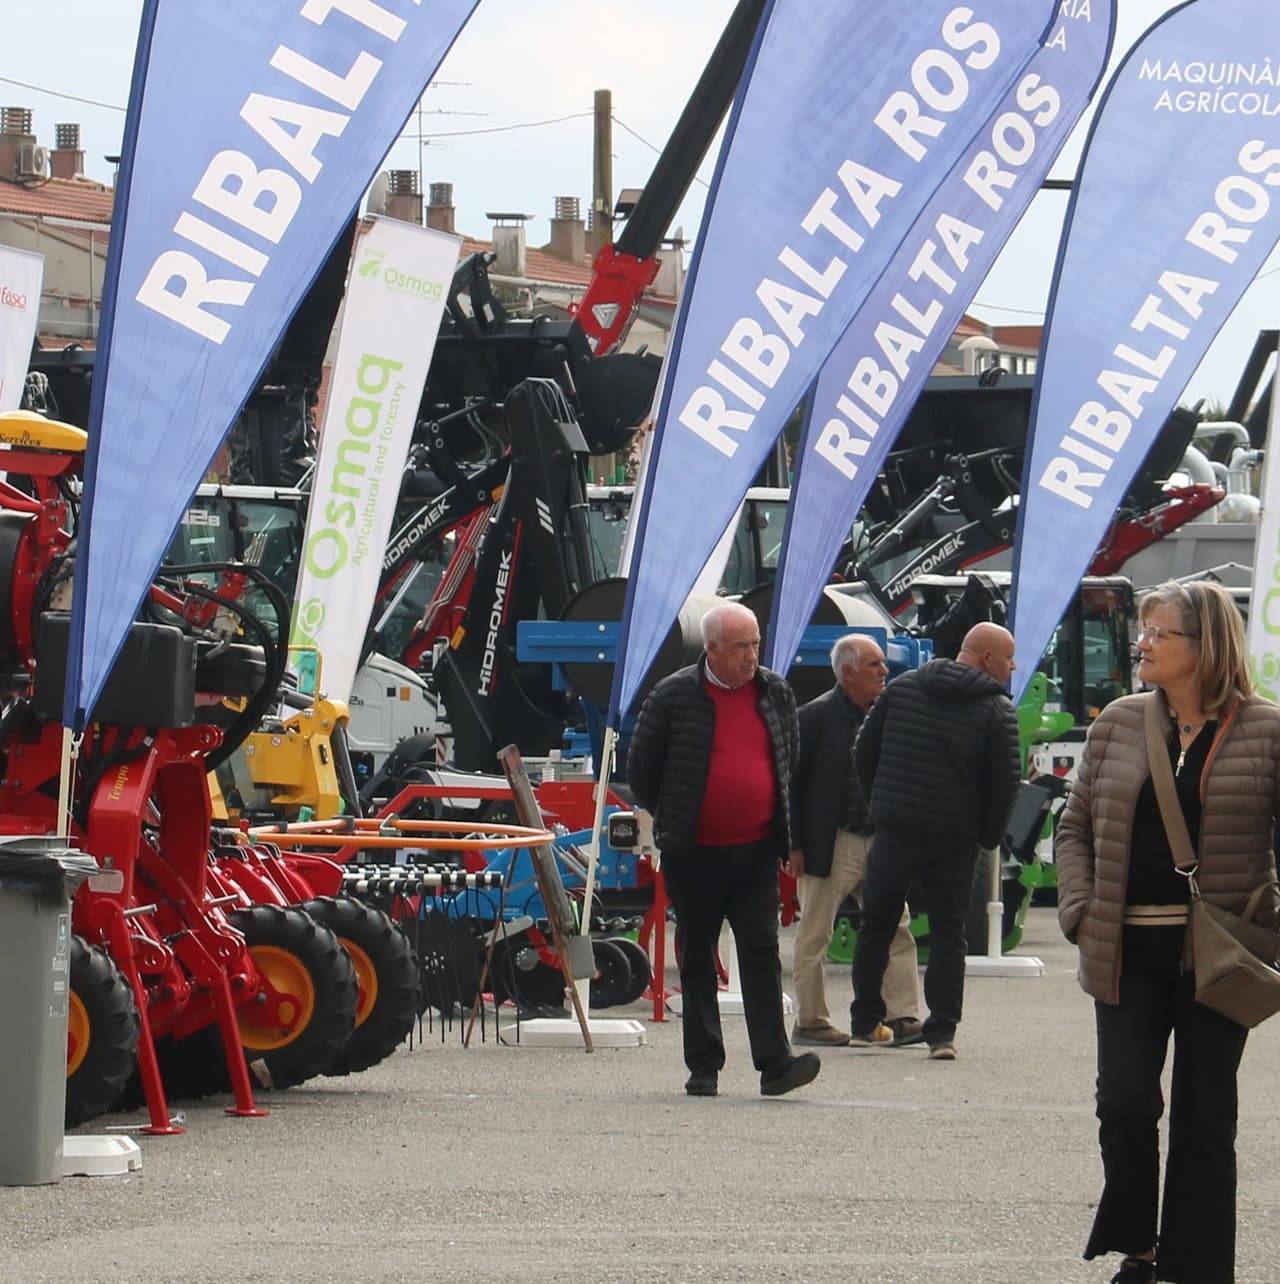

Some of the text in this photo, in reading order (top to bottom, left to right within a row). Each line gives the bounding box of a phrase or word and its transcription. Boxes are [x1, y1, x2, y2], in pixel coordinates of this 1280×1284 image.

[135, 0, 423, 345] RIBALT
[384, 267, 444, 300] Osmaq
[678, 6, 1001, 458] RIBALTA ROS
[814, 73, 1061, 480] RIBALTA ROS
[305, 353, 404, 581] Osmaq
[352, 381, 405, 567] Agricultural and forestry
[1039, 270, 1220, 509] RIBALTA
[107, 765, 129, 801] Tempo
